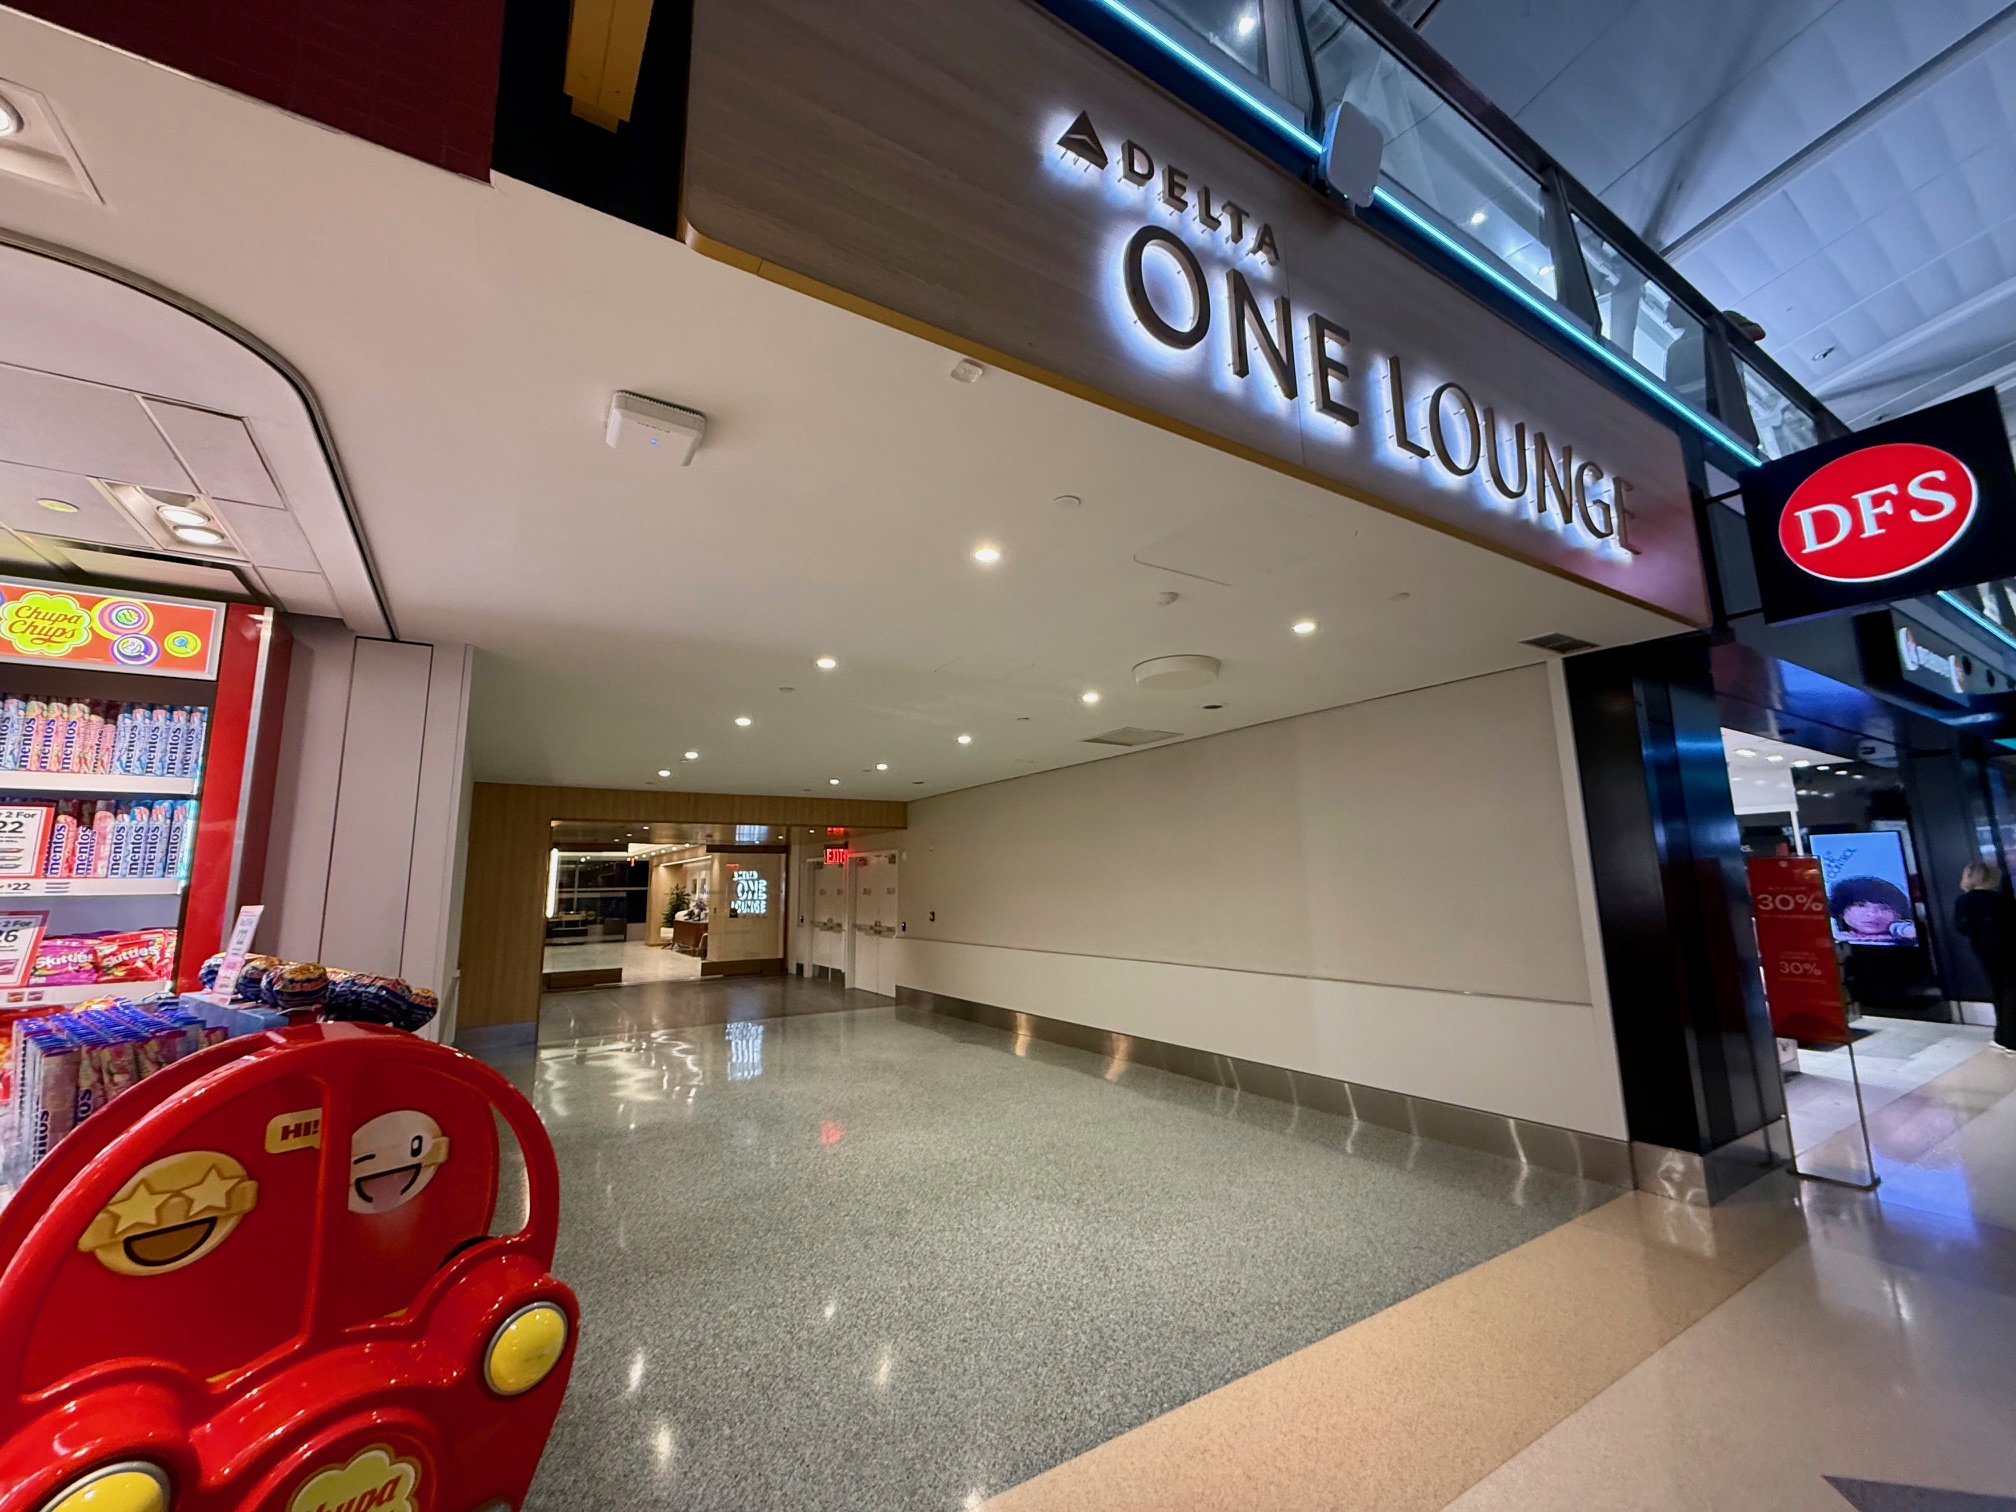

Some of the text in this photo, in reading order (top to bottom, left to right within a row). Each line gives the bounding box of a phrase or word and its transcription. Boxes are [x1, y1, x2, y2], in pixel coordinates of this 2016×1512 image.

[1120, 139, 1280, 267] DELTA
[1123, 224, 1642, 556] ONE LOUNGE
[1794, 469, 1957, 554] DFS
[8, 619, 79, 644] Chups
[14, 605, 83, 625] Chupa
[19, 717, 36, 769] mentos
[39, 719, 56, 770] mentos
[61, 720, 78, 771] mentos
[145, 726, 160, 774] mentos
[166, 727, 182, 775] mentos
[50, 825, 66, 875] mentos
[75, 826, 92, 875] mentos
[110, 826, 126, 876] mentos
[128, 826, 144, 876] mentos
[145, 826, 160, 875] mentos
[166, 826, 181, 875] mentos
[826, 848, 844, 863] EXIT
[1757, 893, 1824, 911] 30%
[1780, 961, 1822, 976] 30%
[281, 1119, 320, 1141] HI!
